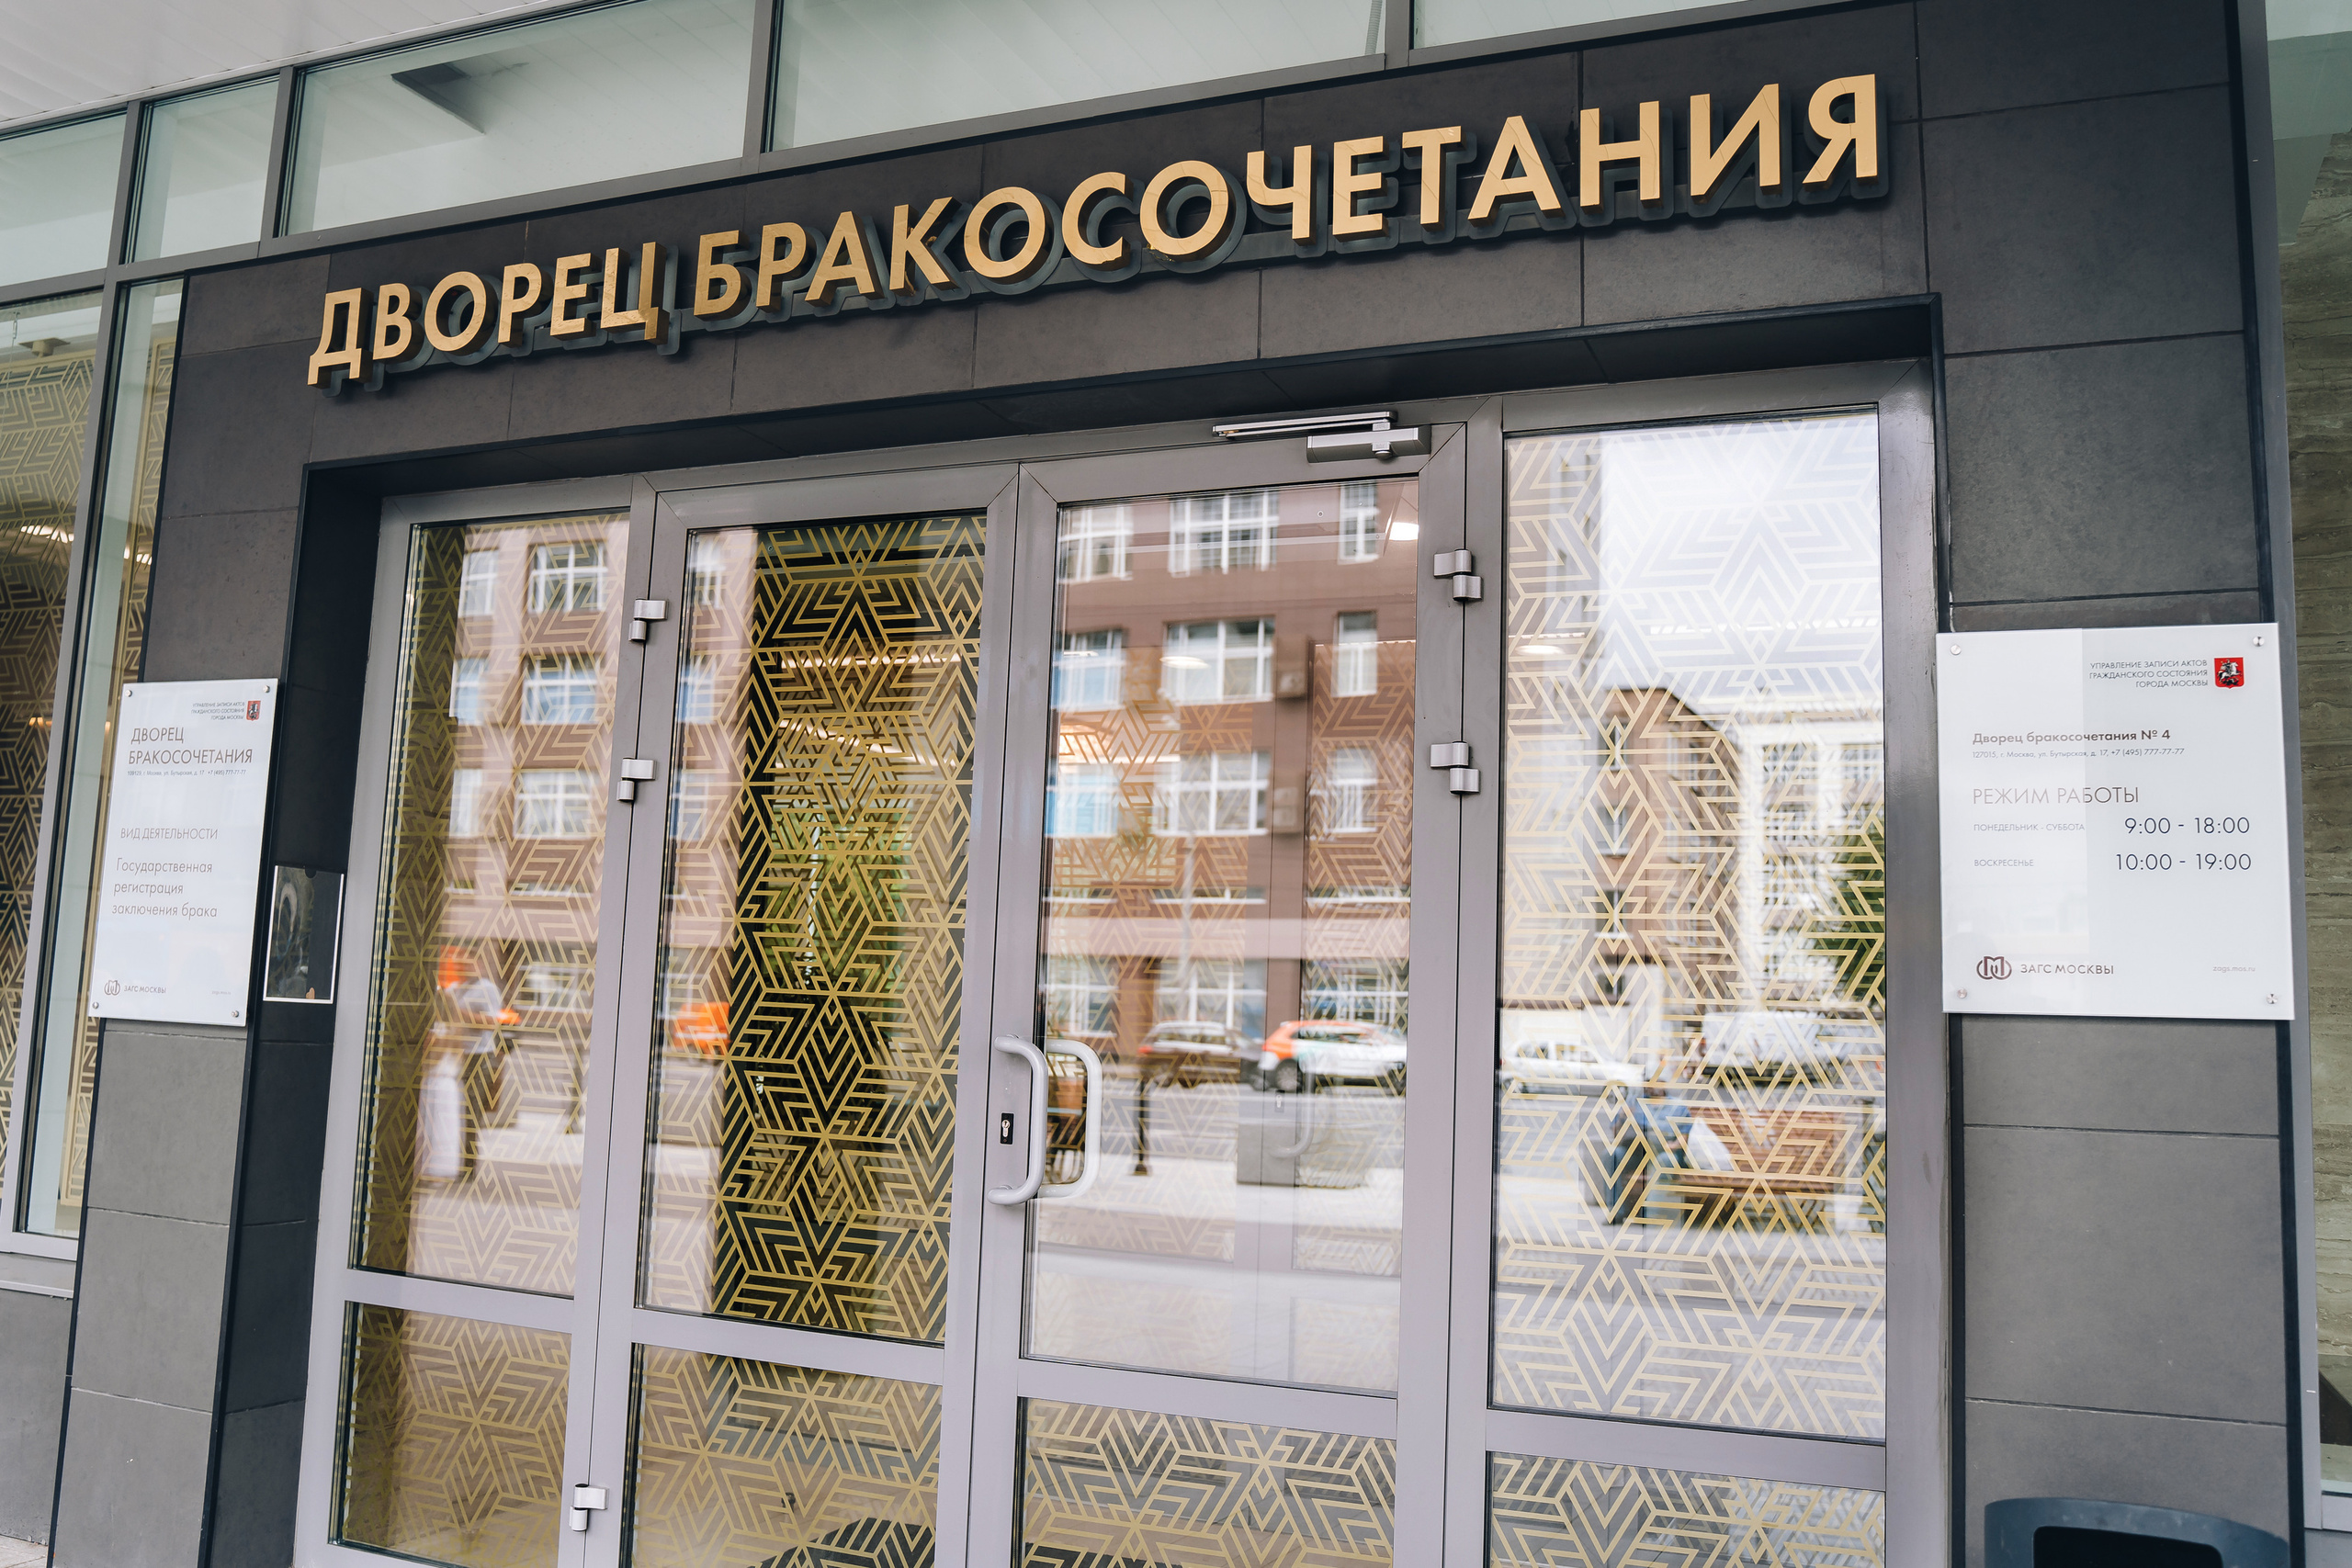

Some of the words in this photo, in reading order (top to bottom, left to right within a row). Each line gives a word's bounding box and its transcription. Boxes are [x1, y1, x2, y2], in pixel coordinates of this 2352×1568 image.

[308, 242, 670, 387] ДВОРЕЦ
[692, 74, 1879, 320] БРАКОСОЧЕТАНИЯ
[2089, 660, 2142, 670] УПРАВЛЕНИЕ
[2143, 660, 2179, 669] ЗАПИСИ
[2180, 660, 2208, 668] АКТОВ
[2089, 671, 2154, 680] ГРАЖДАНСКОГО
[2156, 670, 2208, 679] СОСТОЯНИЯ
[2135, 681, 2169, 689] ГОРОДА
[2171, 680, 2209, 688] МОСКВЫ
[130, 727, 184, 744] ДВОРЕЦ
[1973, 733, 2023, 745] Дворец
[2026, 731, 2137, 744] бракосочетания
[2161, 729, 2171, 740] 4
[129, 749, 253, 764] БРАКОСОЧЕТАНИЯ
[2122, 749, 2143, 757] (495)
[2143, 748, 2185, 756] 777-77-77
[1973, 787, 2050, 805] РЕЖИМ
[2057, 786, 2139, 804] РАБОТЫ
[1973, 824, 2039, 832] ПОНЕДЕЛЬНИК
[2045, 823, 2085, 831] СУББОТА
[2125, 818, 2171, 834] 9:00
[2194, 817, 2250, 834] 18:00
[120, 828, 141, 840] ВИД
[141, 828, 219, 840] ДЕЯТЕЛЬНОСТИ
[116, 858, 213, 876] Государственная
[1974, 859, 2034, 867] ВОСКРЕСЕНЬЕ
[2116, 853, 2172, 871] 10:00
[2195, 853, 2251, 871] 19:00
[113, 882, 184, 897] регистрация
[112, 903, 178, 917] заключения
[181, 902, 218, 920] брака
[2020, 964, 2052, 975] ЗАГС
[2055, 964, 2114, 975] МОСКВЫ
[2212, 965, 2256, 974] zags.mos.ru
[139, 986, 166, 994] МОСКВЫ
